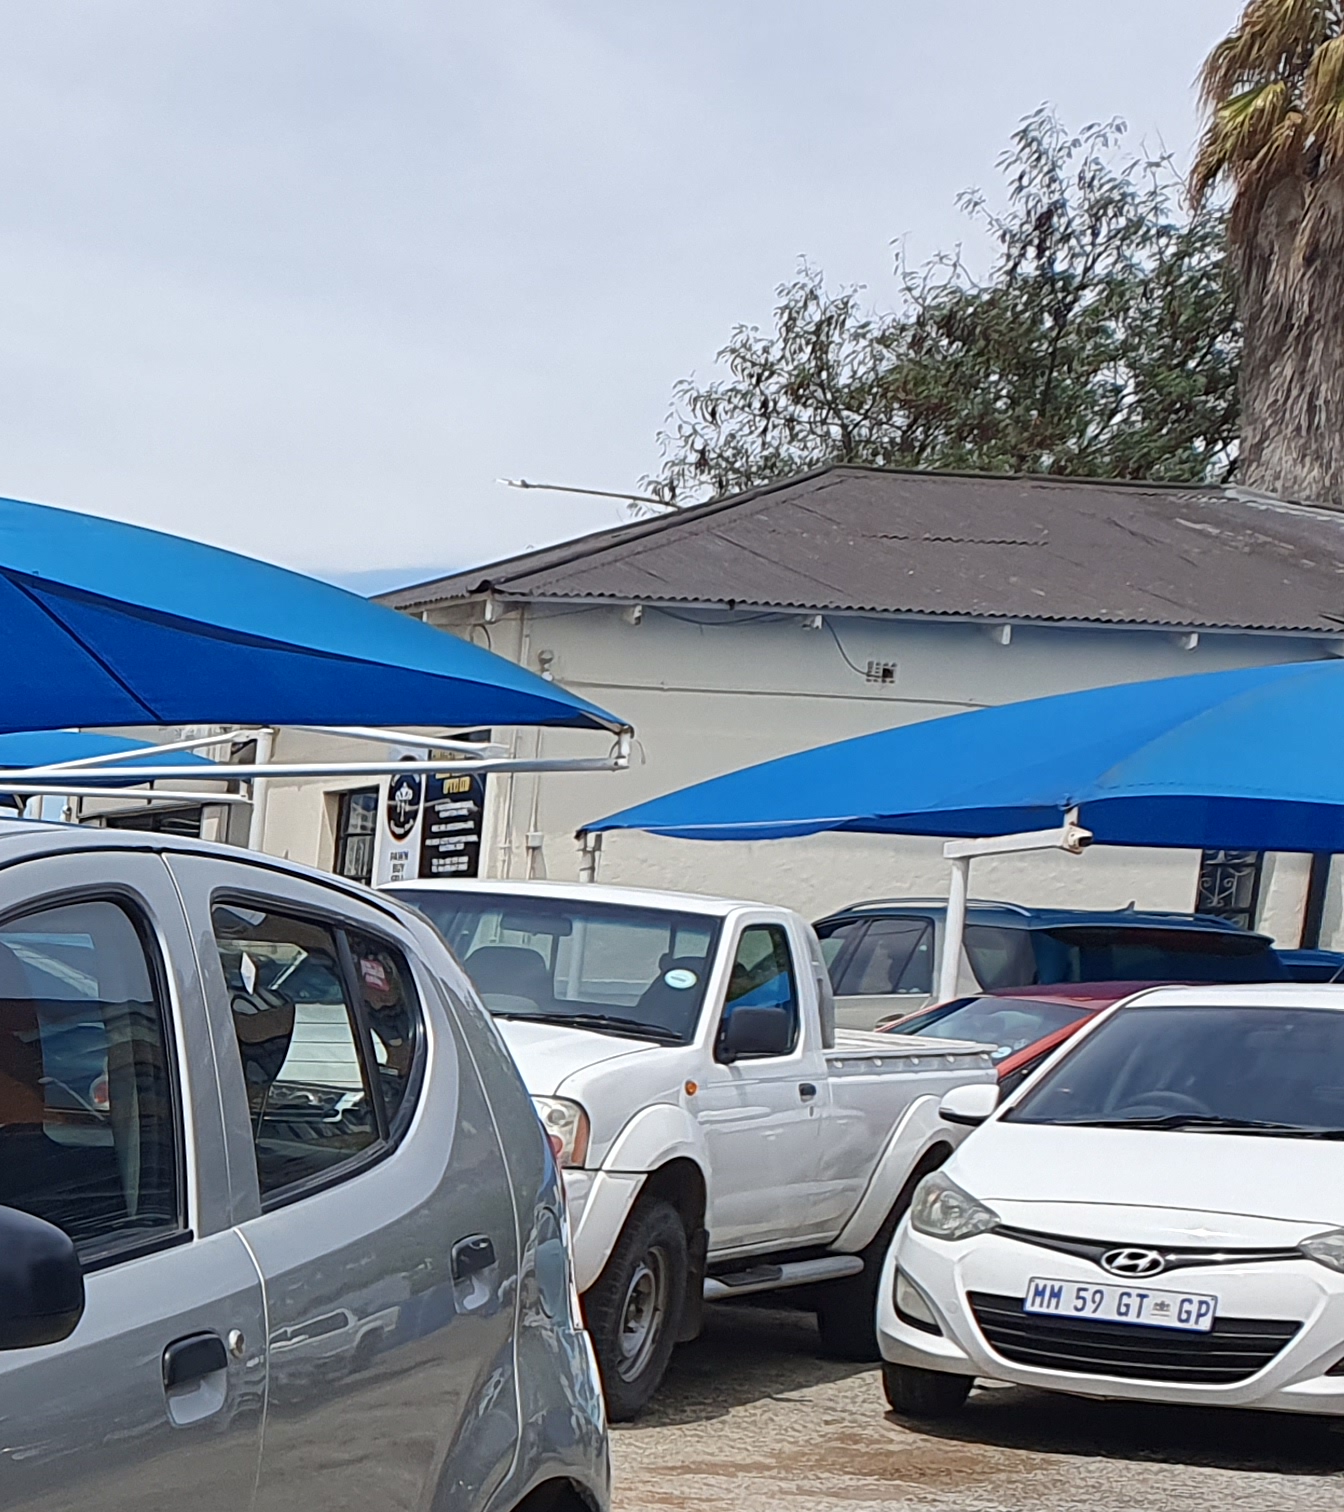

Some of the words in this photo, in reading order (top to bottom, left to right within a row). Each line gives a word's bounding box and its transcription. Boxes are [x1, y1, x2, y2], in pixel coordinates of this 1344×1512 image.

[1030, 1282, 1063, 1310] MM
[1072, 1287, 1105, 1314] 59
[1116, 1291, 1150, 1319] GT
[1177, 1298, 1211, 1326] GP
